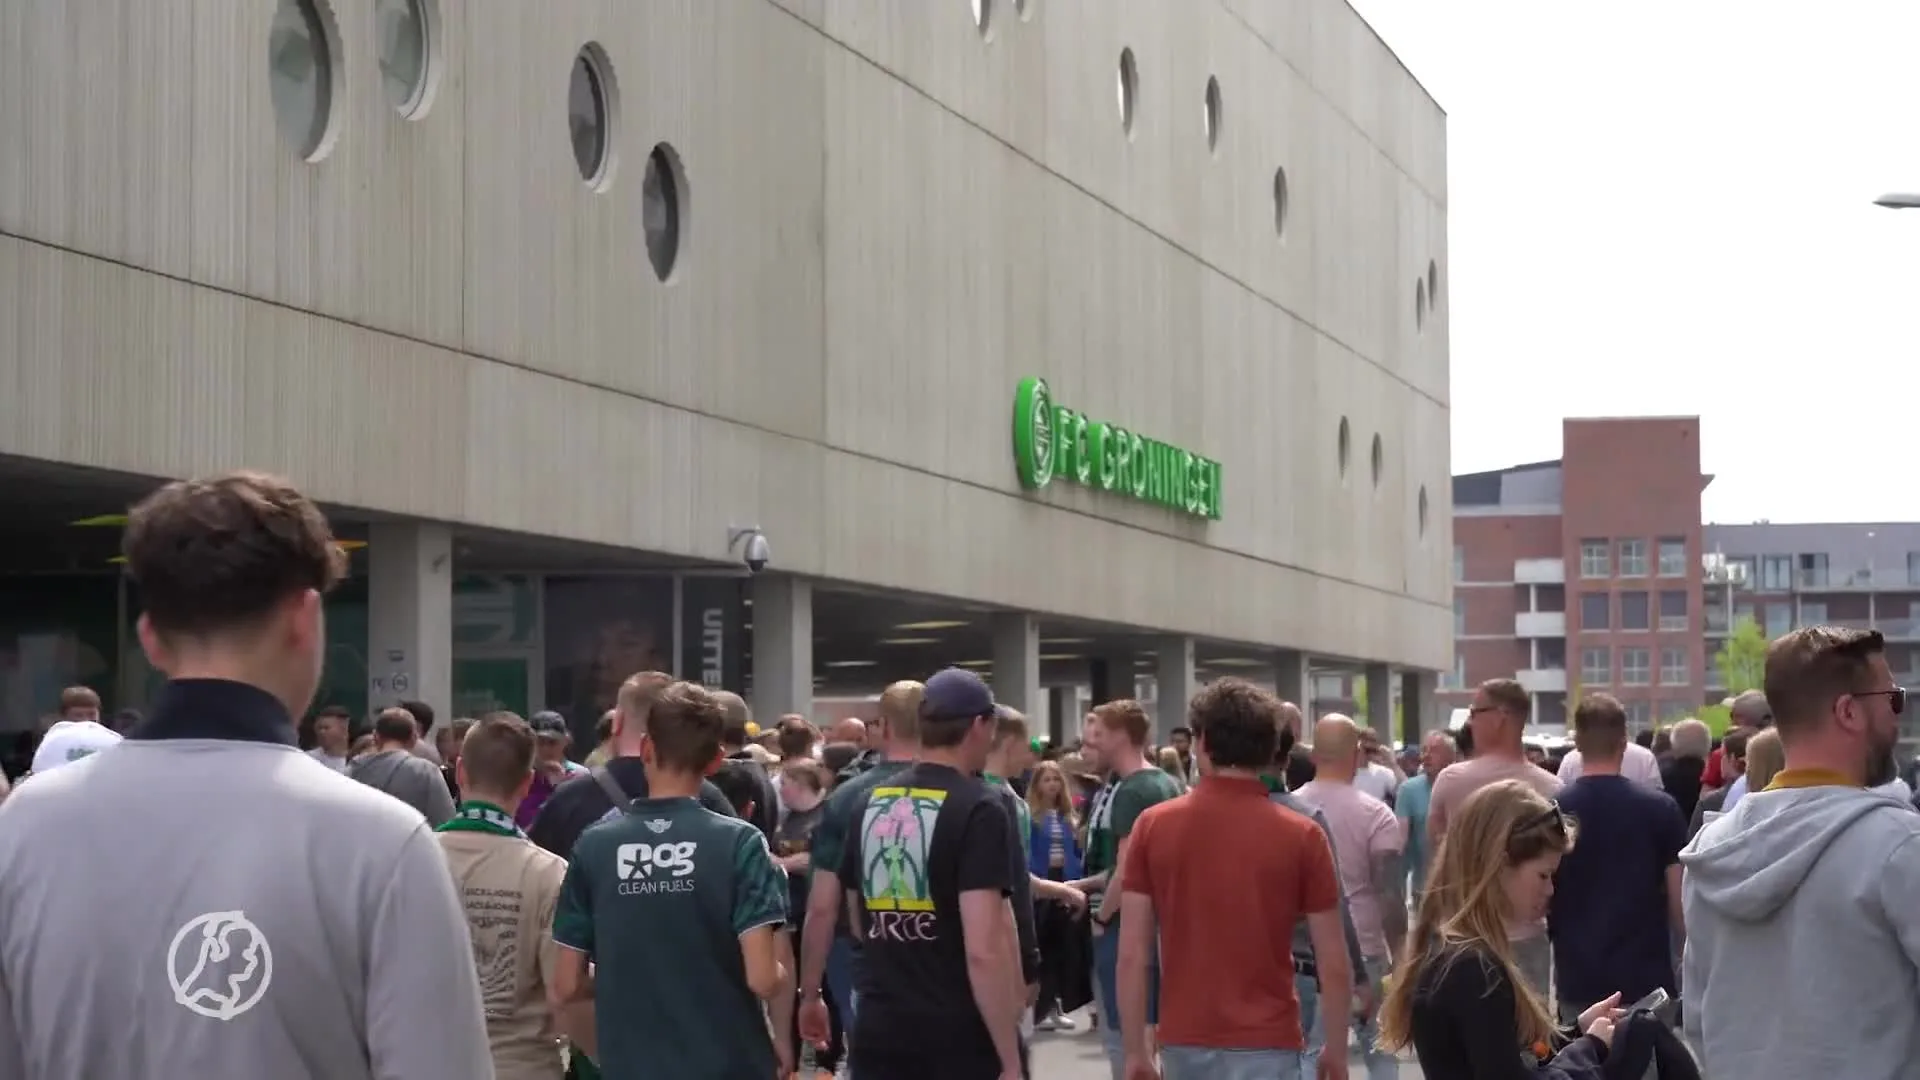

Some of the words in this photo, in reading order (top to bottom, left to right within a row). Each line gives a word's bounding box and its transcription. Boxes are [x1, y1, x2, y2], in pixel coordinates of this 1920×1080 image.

[1054, 405, 1090, 485] FC
[1092, 423, 1222, 520] GRONINGEN
[618, 882, 657, 895] CLEAN
[660, 880, 695, 893] FUELS
